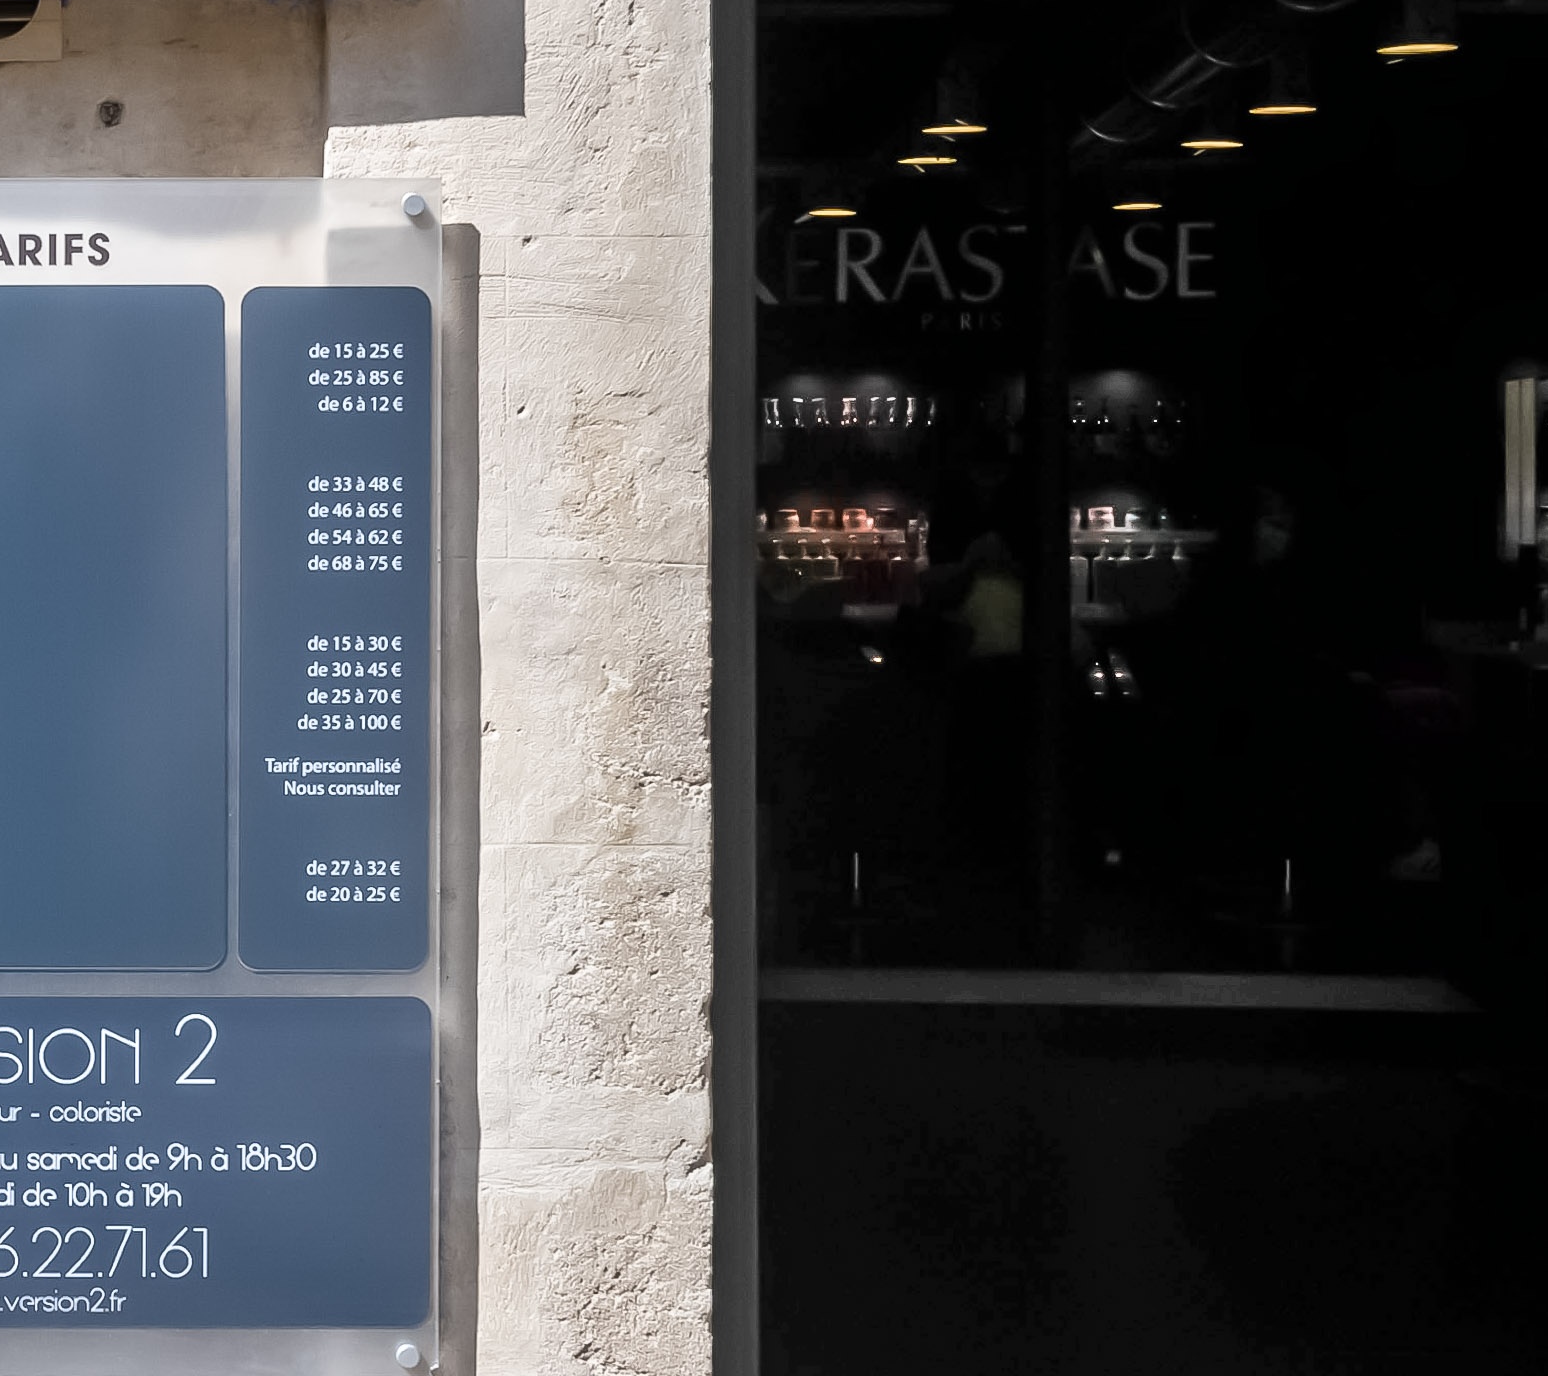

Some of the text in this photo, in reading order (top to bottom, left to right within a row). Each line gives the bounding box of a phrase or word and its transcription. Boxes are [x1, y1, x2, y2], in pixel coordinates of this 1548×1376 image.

[308, 342, 404, 359] de 15 à 25 €
[317, 395, 404, 412] de 6 à 12 €
[307, 501, 403, 518] de 46 à 65 €
[307, 660, 402, 678] de 30 à 45 €
[264, 756, 402, 777] Tarif personnalisé
[284, 779, 402, 796] Nous consulter
[174, 1013, 218, 1085] 2
[49, 1100, 142, 1123] coloriste
[26, 1145, 118, 1171] samedi
[125, 1145, 160, 1171] de
[166, 1142, 203, 1171] 9h
[210, 1146, 229, 1172] à
[236, 1142, 317, 1171] 18h30
[22, 1181, 58, 1207] de
[63, 1181, 108, 1207] 10h
[115, 1182, 134, 1208] à
[141, 1182, 182, 1208] 19h
